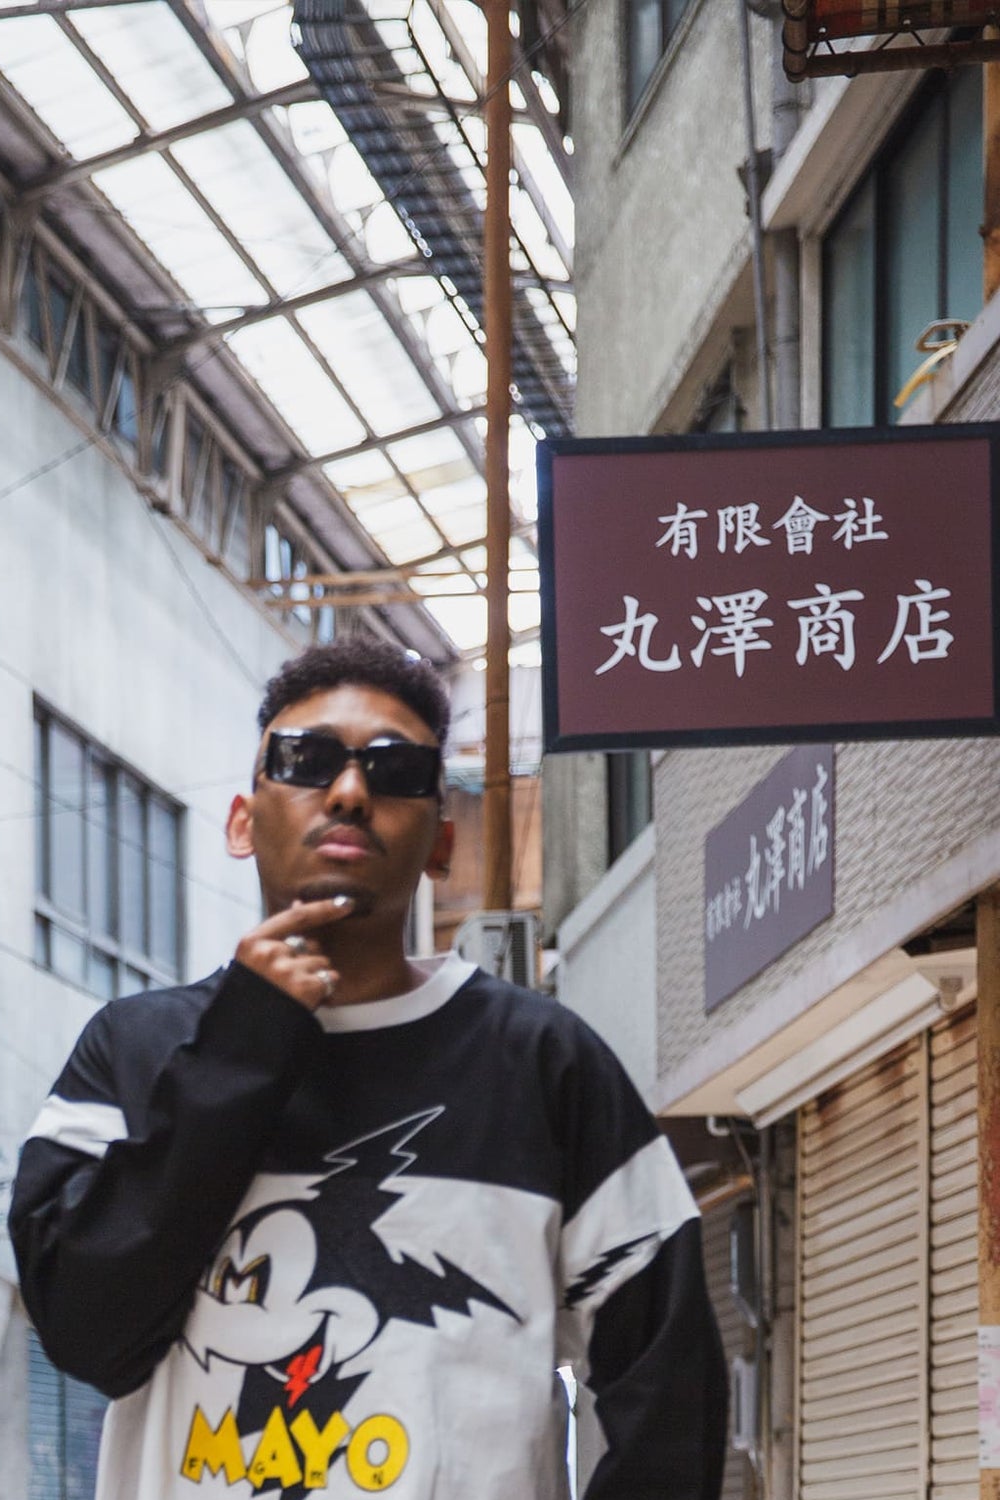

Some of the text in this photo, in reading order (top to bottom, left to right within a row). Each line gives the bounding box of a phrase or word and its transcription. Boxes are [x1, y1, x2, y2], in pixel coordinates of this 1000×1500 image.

[654, 494, 890, 560] 有限會社
[594, 578, 955, 679] 丸澤商店
[743, 762, 829, 930] 丸澤商店
[180, 1403, 411, 1493] MAYO
